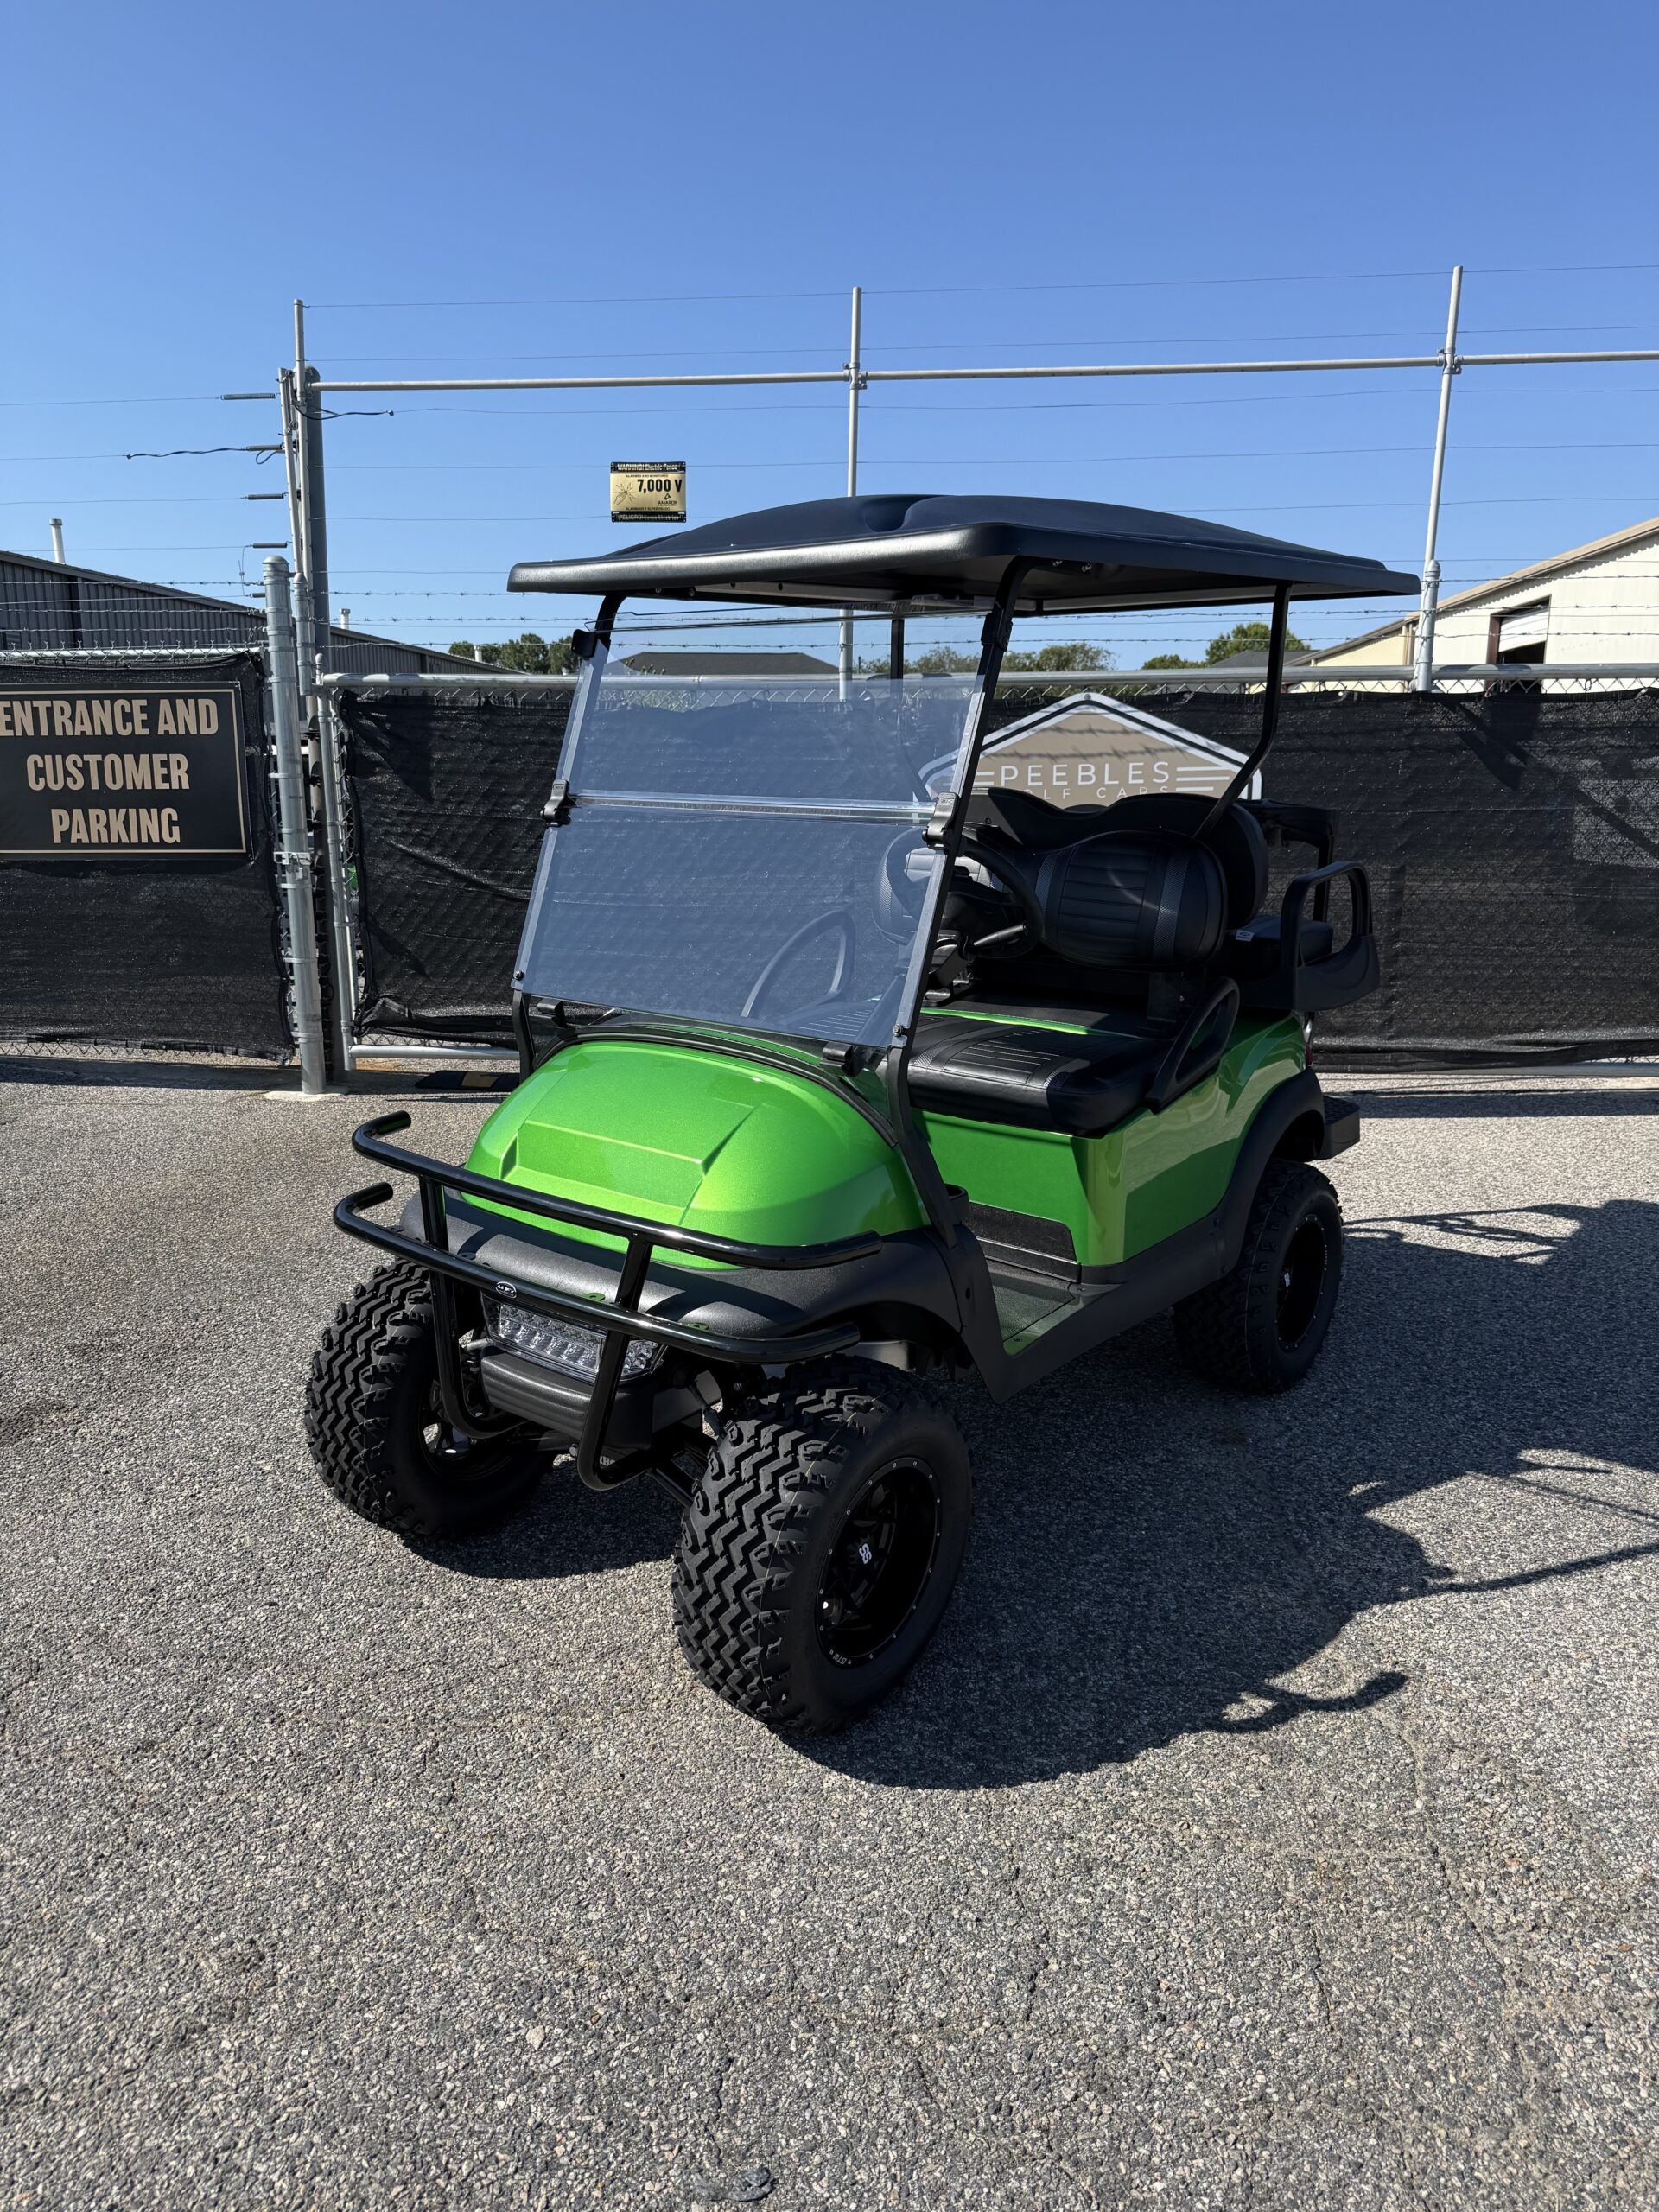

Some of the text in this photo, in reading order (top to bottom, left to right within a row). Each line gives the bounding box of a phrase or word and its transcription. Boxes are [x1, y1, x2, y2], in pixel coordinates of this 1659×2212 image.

[637, 479, 683, 493] 7,000 V
[0, 698, 219, 736] ENTRANCE AND
[27, 753, 190, 791] CUSTOMER
[1001, 761, 1169, 787] PEEBLES
[51, 807, 181, 844] PARKING
